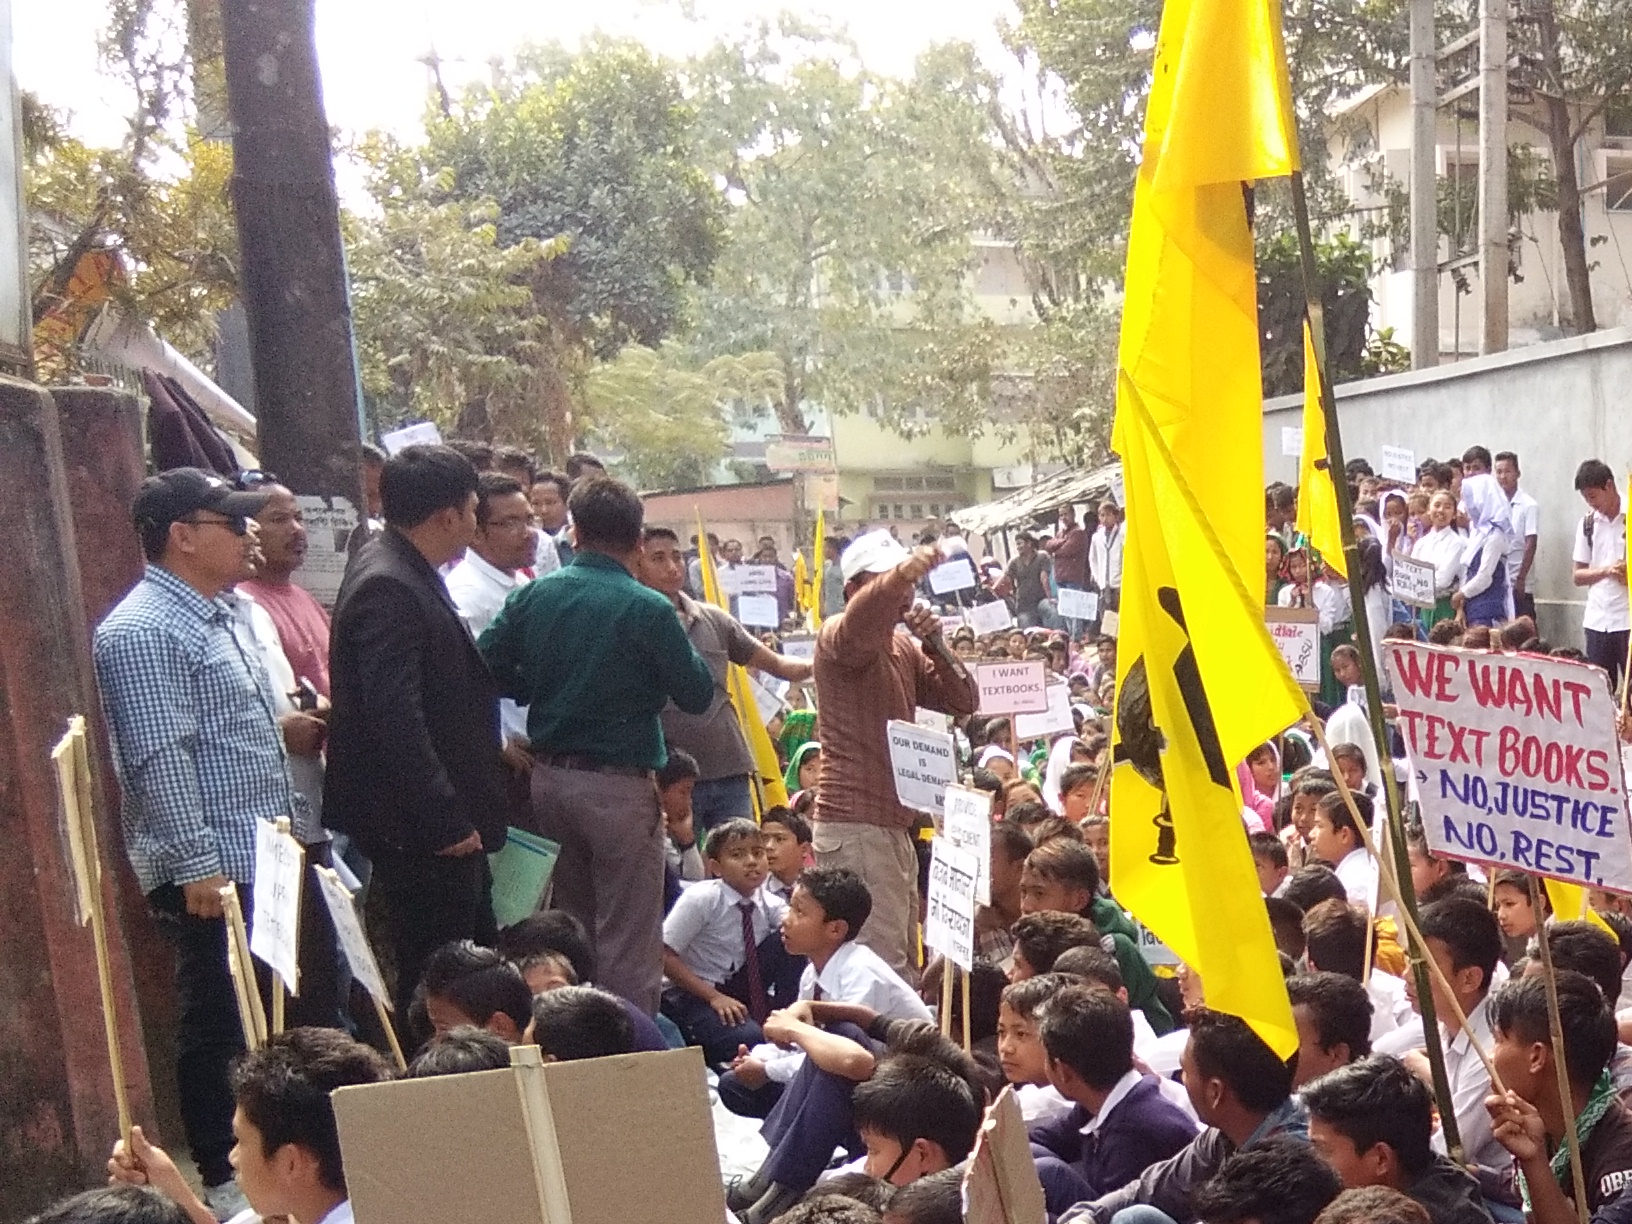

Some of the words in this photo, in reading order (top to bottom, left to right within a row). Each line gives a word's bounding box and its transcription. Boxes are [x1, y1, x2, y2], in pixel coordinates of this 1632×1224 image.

[999, 667, 1030, 677] WANT
[1393, 649, 1461, 702] WE
[1468, 660, 1591, 729] WANT
[892, 736, 911, 749] OUR
[912, 741, 949, 758] DEMAND
[1401, 709, 1490, 768] TEXT
[1499, 726, 1618, 794] BOOKS.
[919, 758, 927, 768] IS
[897, 767, 921, 781] LEGAL
